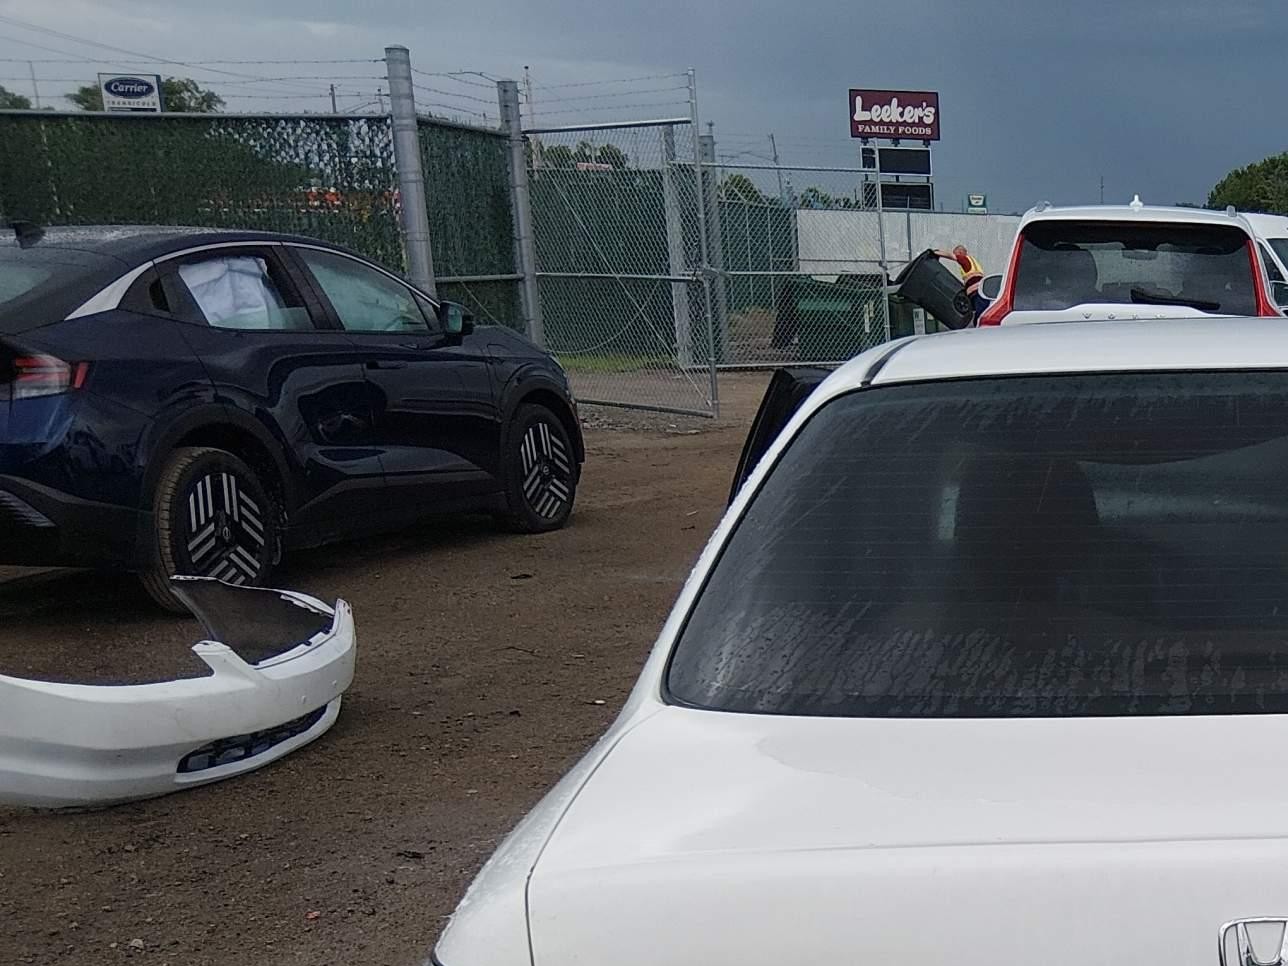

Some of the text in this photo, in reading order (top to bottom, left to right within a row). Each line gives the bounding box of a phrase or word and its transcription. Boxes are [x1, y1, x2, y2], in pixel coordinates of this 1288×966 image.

[111, 82, 148, 92] Carrier
[853, 95, 935, 124] Leeker's
[858, 124, 932, 135] FAMILY FOODS
